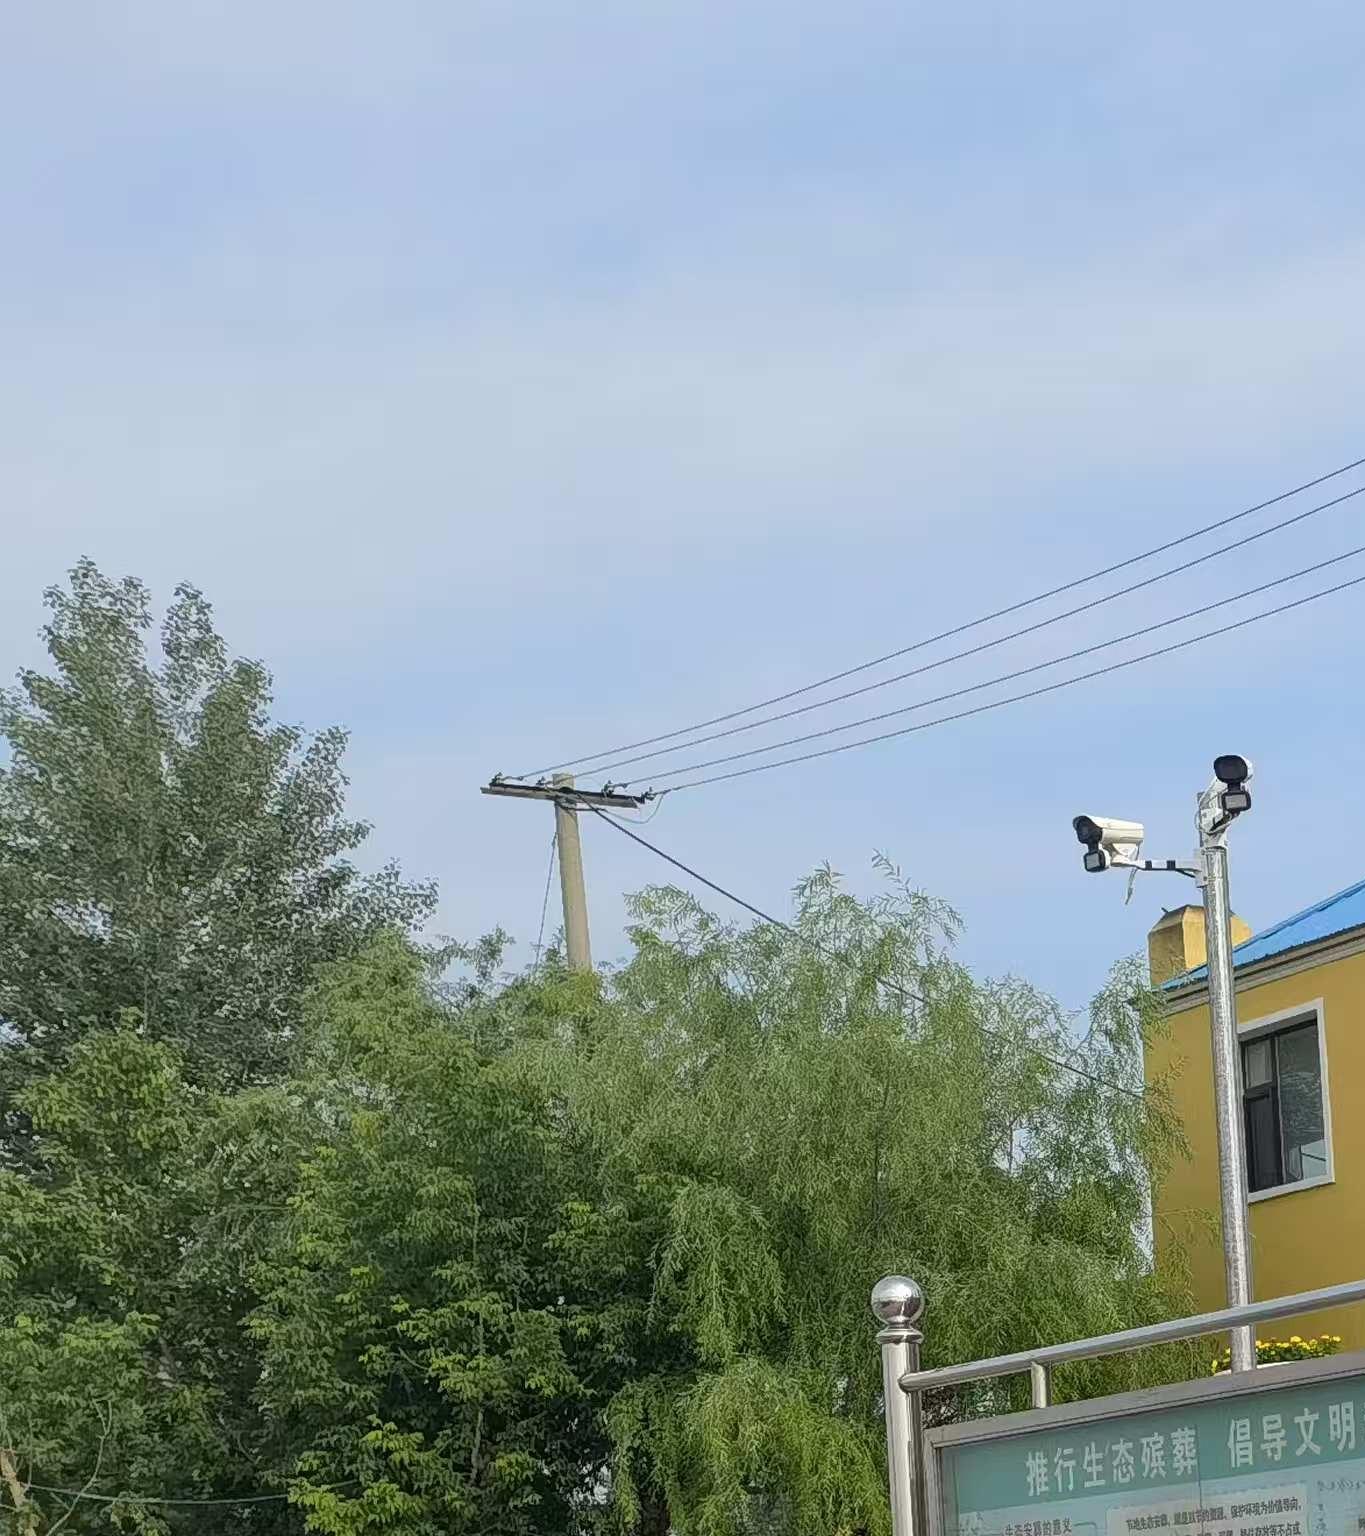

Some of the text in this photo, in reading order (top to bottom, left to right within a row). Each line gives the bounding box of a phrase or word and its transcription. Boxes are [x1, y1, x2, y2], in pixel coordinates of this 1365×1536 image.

[1025, 1429, 1198, 1497] 推行生态殡葬
